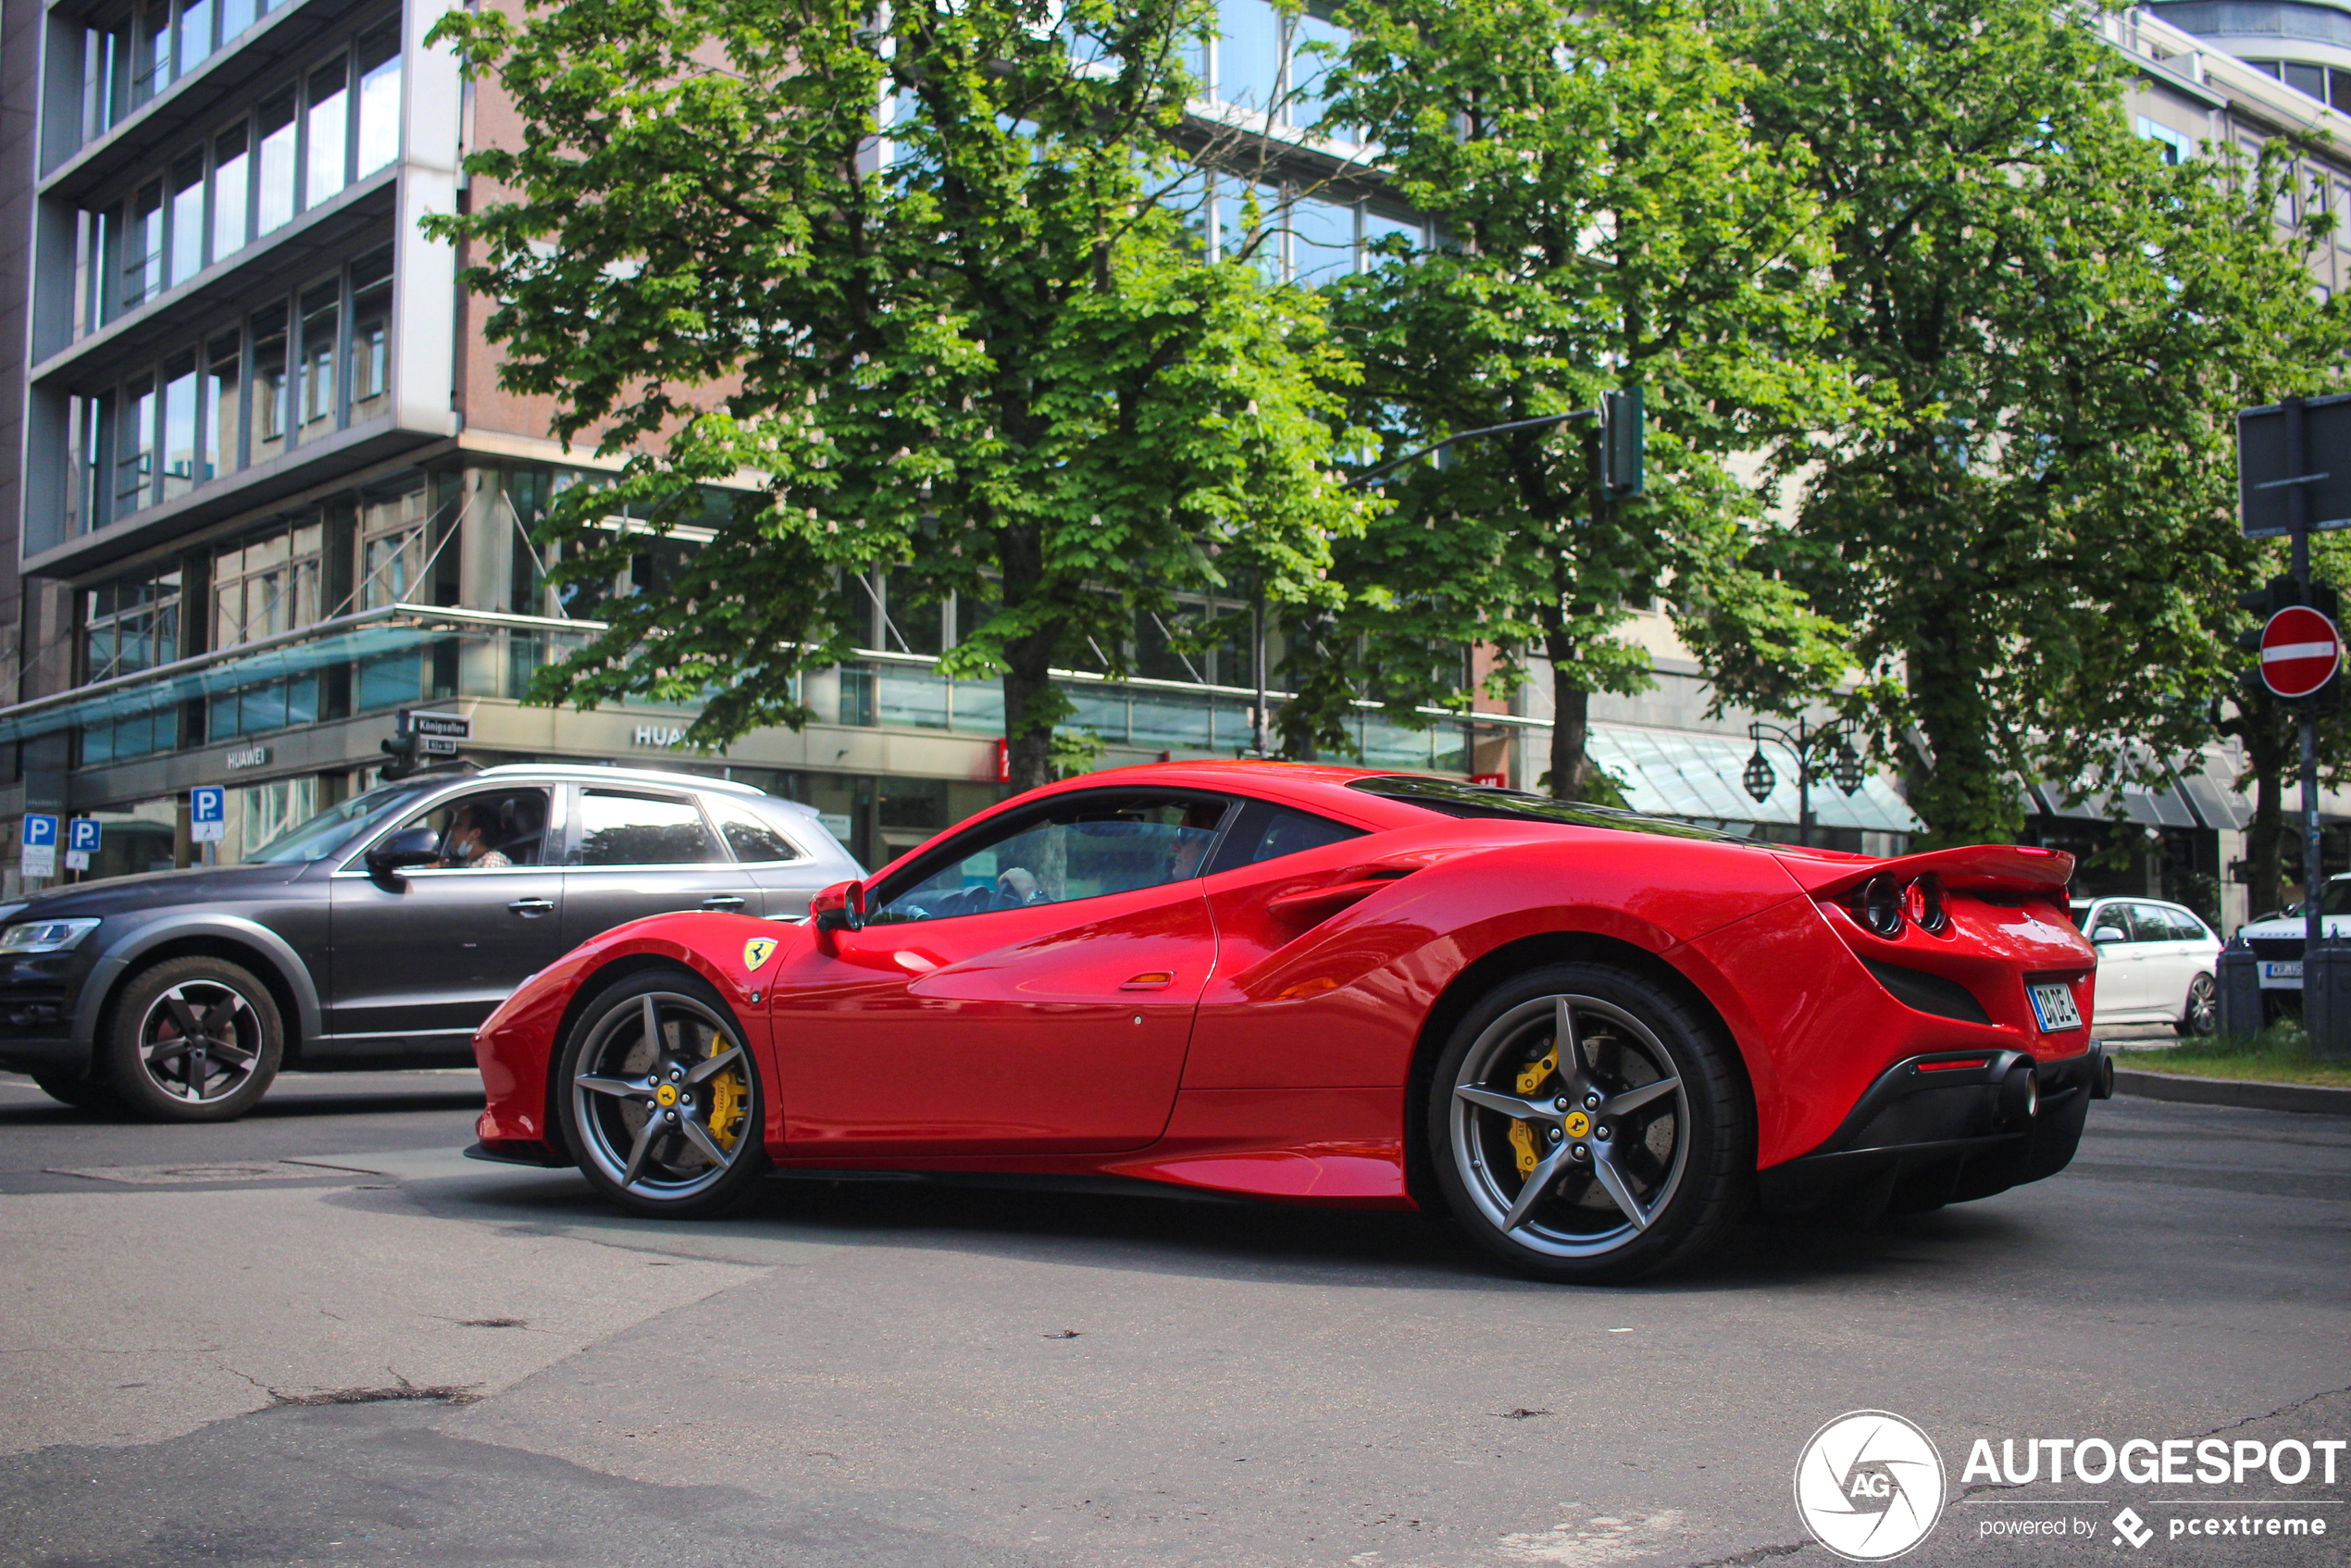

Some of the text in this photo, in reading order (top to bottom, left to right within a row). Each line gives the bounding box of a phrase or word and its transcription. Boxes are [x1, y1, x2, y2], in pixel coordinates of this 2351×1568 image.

[419, 718, 466, 735] Königsallee
[228, 746, 265, 770] HUAWEI
[198, 791, 217, 820] P
[31, 818, 50, 844] P
[76, 823, 93, 848] P
[2036, 988, 2079, 1024] D DE 4
